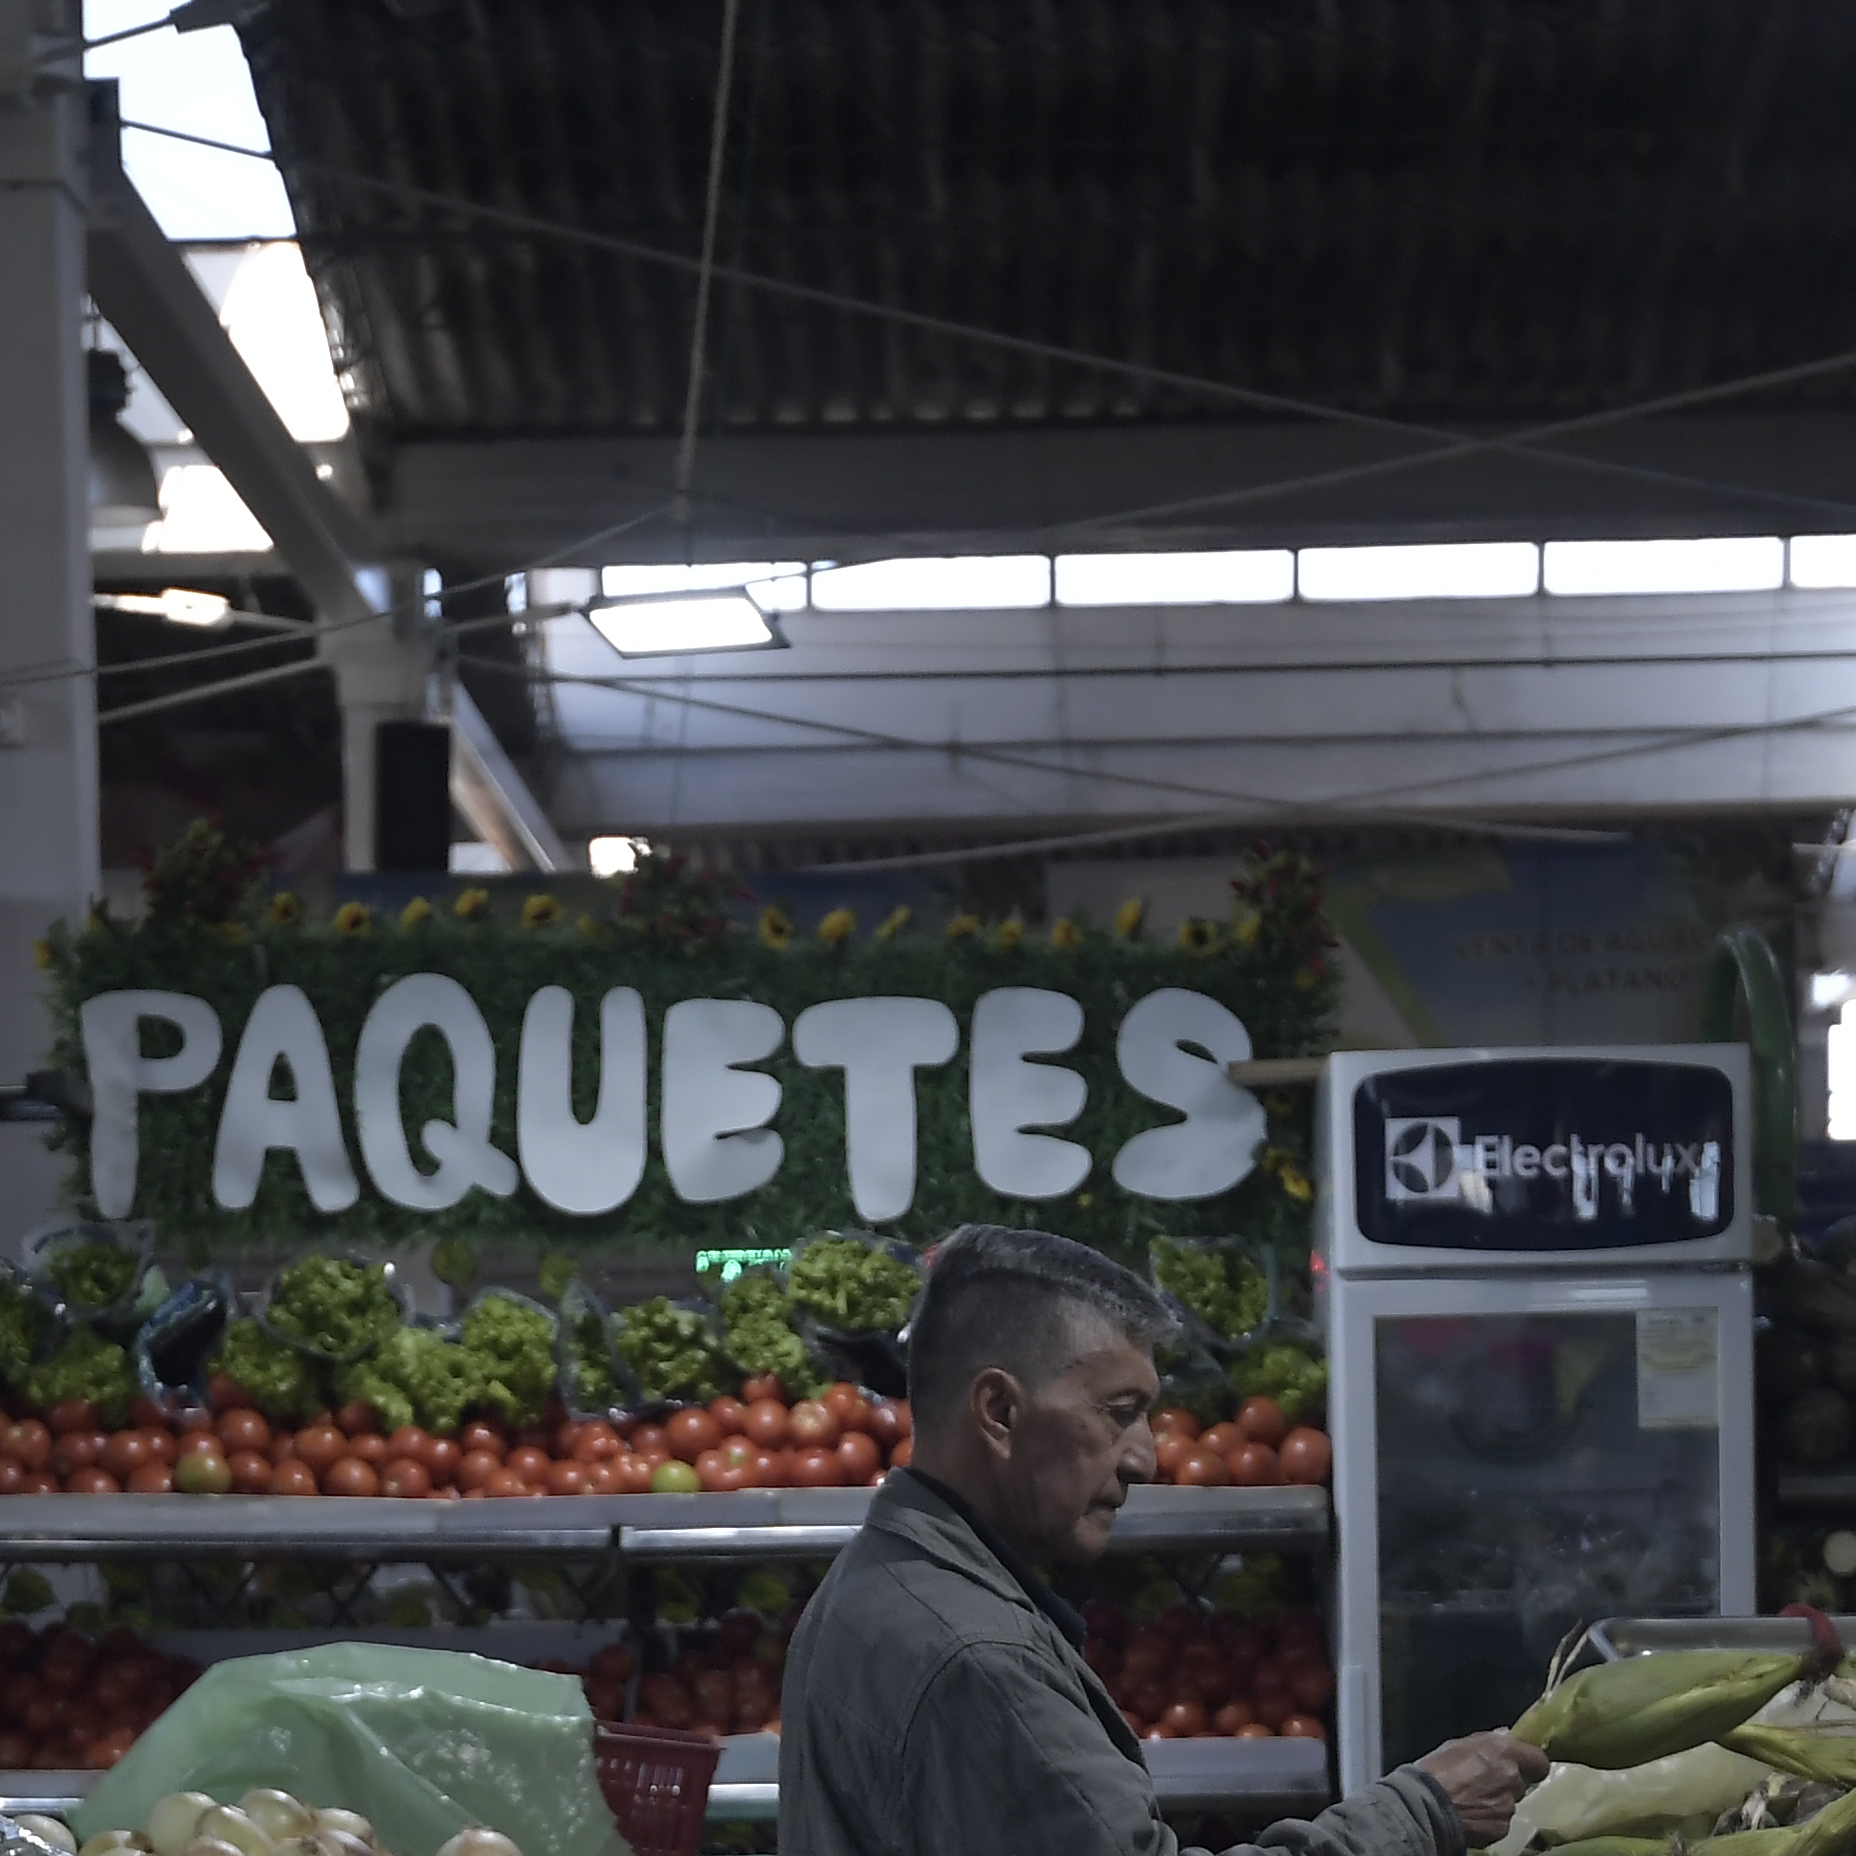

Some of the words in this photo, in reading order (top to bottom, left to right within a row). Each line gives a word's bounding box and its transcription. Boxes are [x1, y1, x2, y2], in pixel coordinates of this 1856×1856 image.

[1556, 930, 1593, 953] DE
[79, 971, 1268, 1223] PAQUETES
[1474, 1132, 1701, 1179] Electrolux
